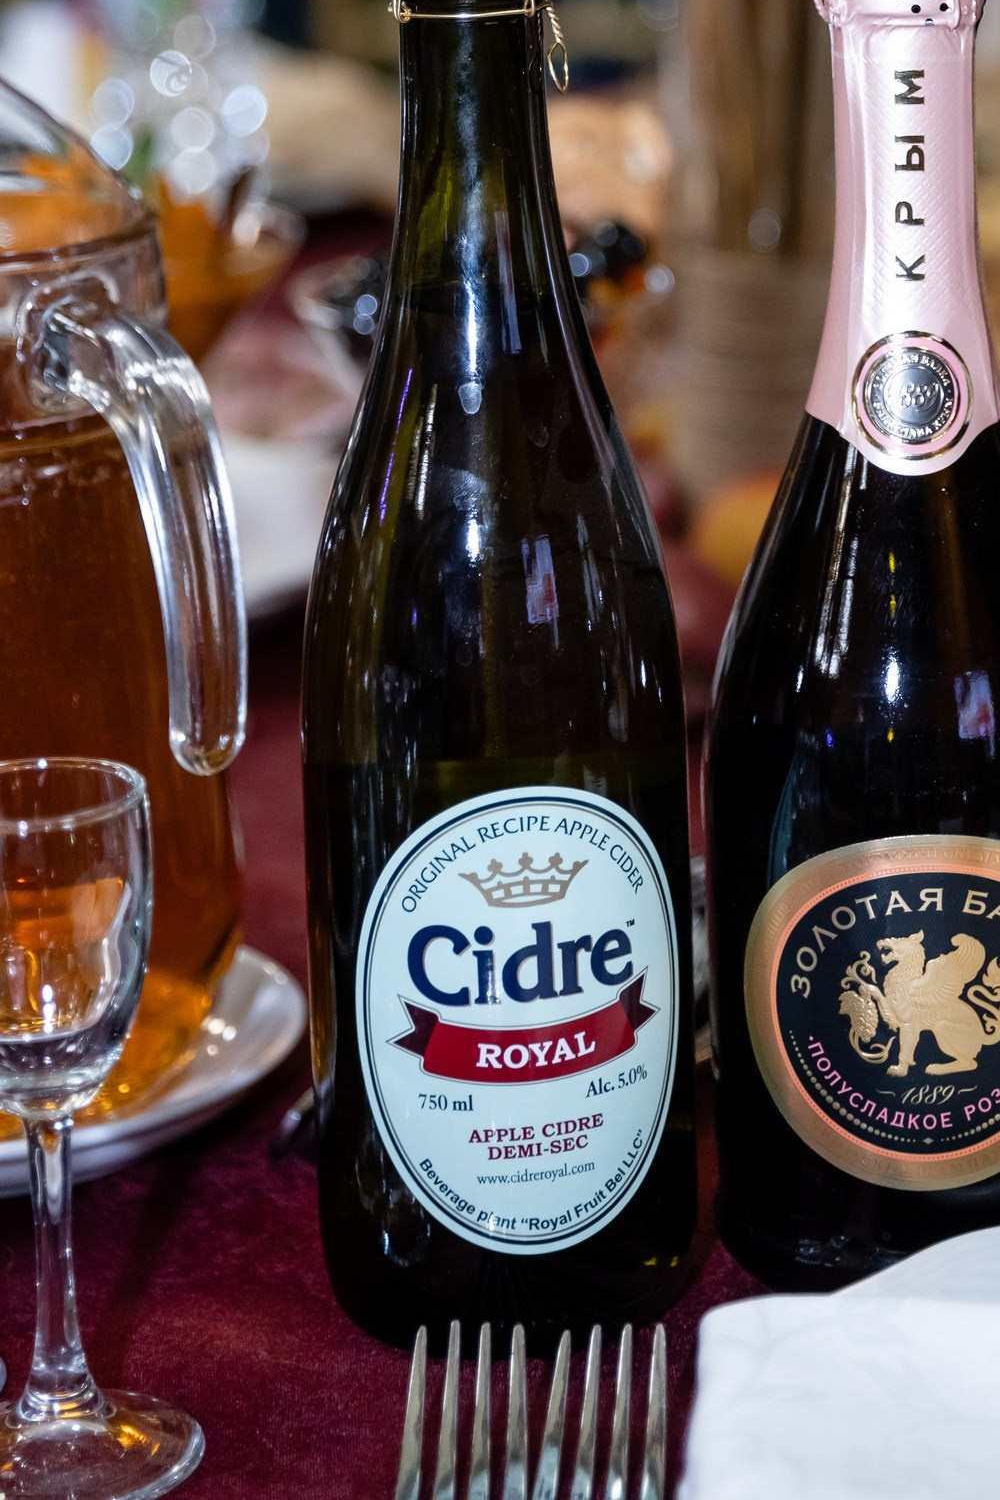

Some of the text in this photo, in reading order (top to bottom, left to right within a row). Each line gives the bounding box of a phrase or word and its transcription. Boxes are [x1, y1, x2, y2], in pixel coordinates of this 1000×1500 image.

[895, 69, 926, 282] КРЫМ
[401, 815, 644, 913] ORIGINAL RECIPE APPLE CIDER
[407, 920, 634, 1007] Cidre
[790, 887, 945, 999] ЗОЛОТАЯ
[475, 1031, 597, 1069] ROYAL
[418, 1063, 648, 1112] 750 ml Alc. 5.0%
[807, 1041, 954, 1130] ПОЛУСЛАДКОЕ
[901, 1083, 956, 1106] 1889
[468, 1113, 605, 1144] APPLE CIDRE
[487, 1134, 589, 1161] DEMI-SEC
[419, 1158, 476, 1215] Beverage
[476, 1209, 518, 1231] plant
[573, 1190, 607, 1219] Fruit
[604, 1168, 627, 1194] Bel
[476, 1161, 596, 1186] www.cidreroyal.com
